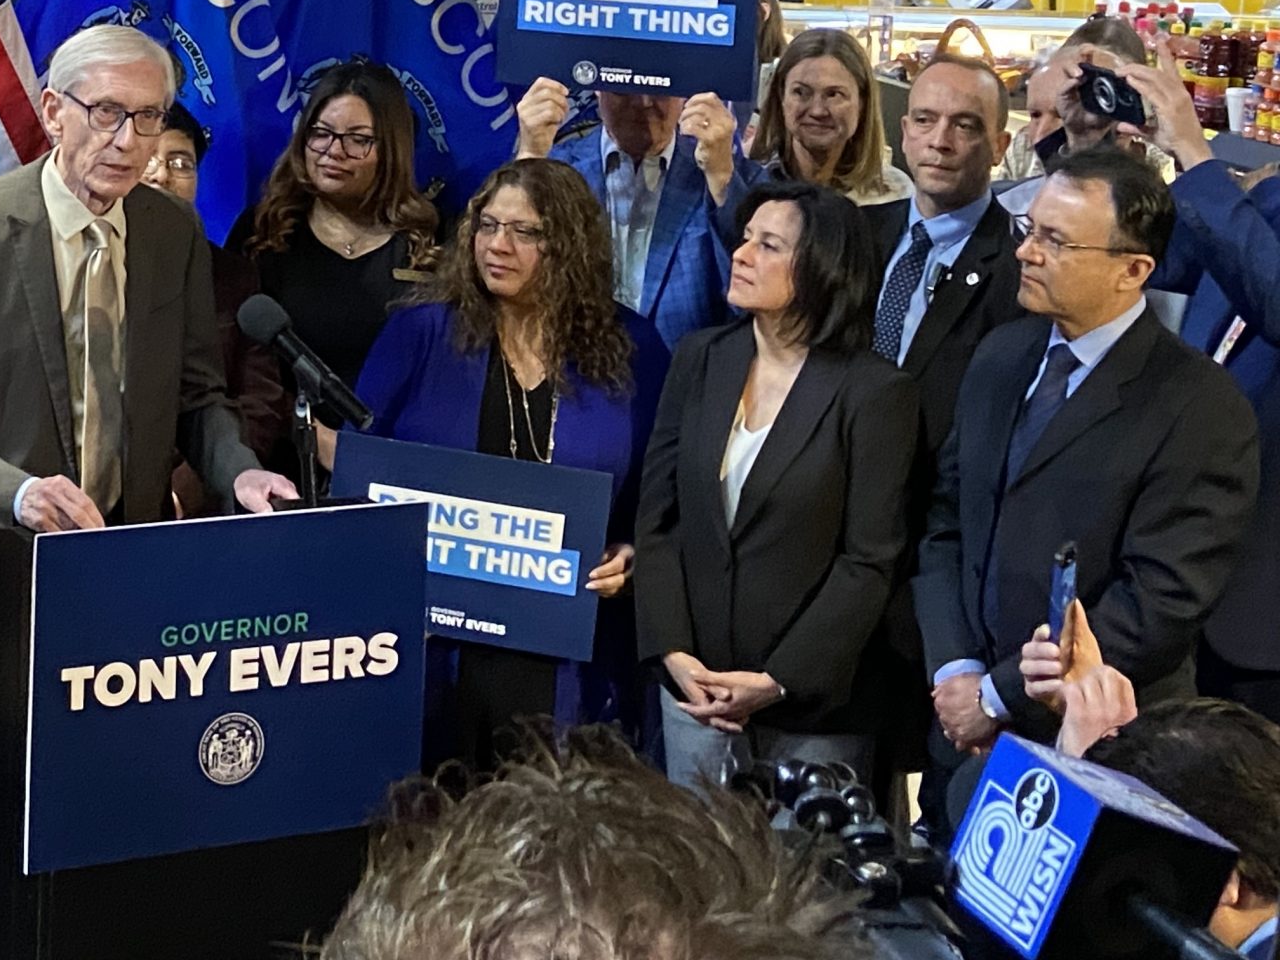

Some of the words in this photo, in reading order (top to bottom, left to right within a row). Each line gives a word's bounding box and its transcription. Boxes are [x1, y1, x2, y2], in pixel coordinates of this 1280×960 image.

[524, 0, 620, 29] RIGHT
[627, 7, 729, 37] THING
[175, 28, 209, 81] FORWARD
[600, 72, 632, 83] TONY
[633, 74, 671, 87] EVERS
[406, 76, 443, 129] FORWARD
[490, 511, 553, 543] THE
[464, 543, 572, 585] THING
[160, 612, 310, 648] GOVERNOR
[429, 612, 465, 628] TONY
[465, 618, 506, 636] EVERS
[60, 651, 218, 711] TONY
[229, 632, 400, 693] EVERS
[1020, 772, 1051, 829] abc
[1009, 835, 1070, 937] WISN
